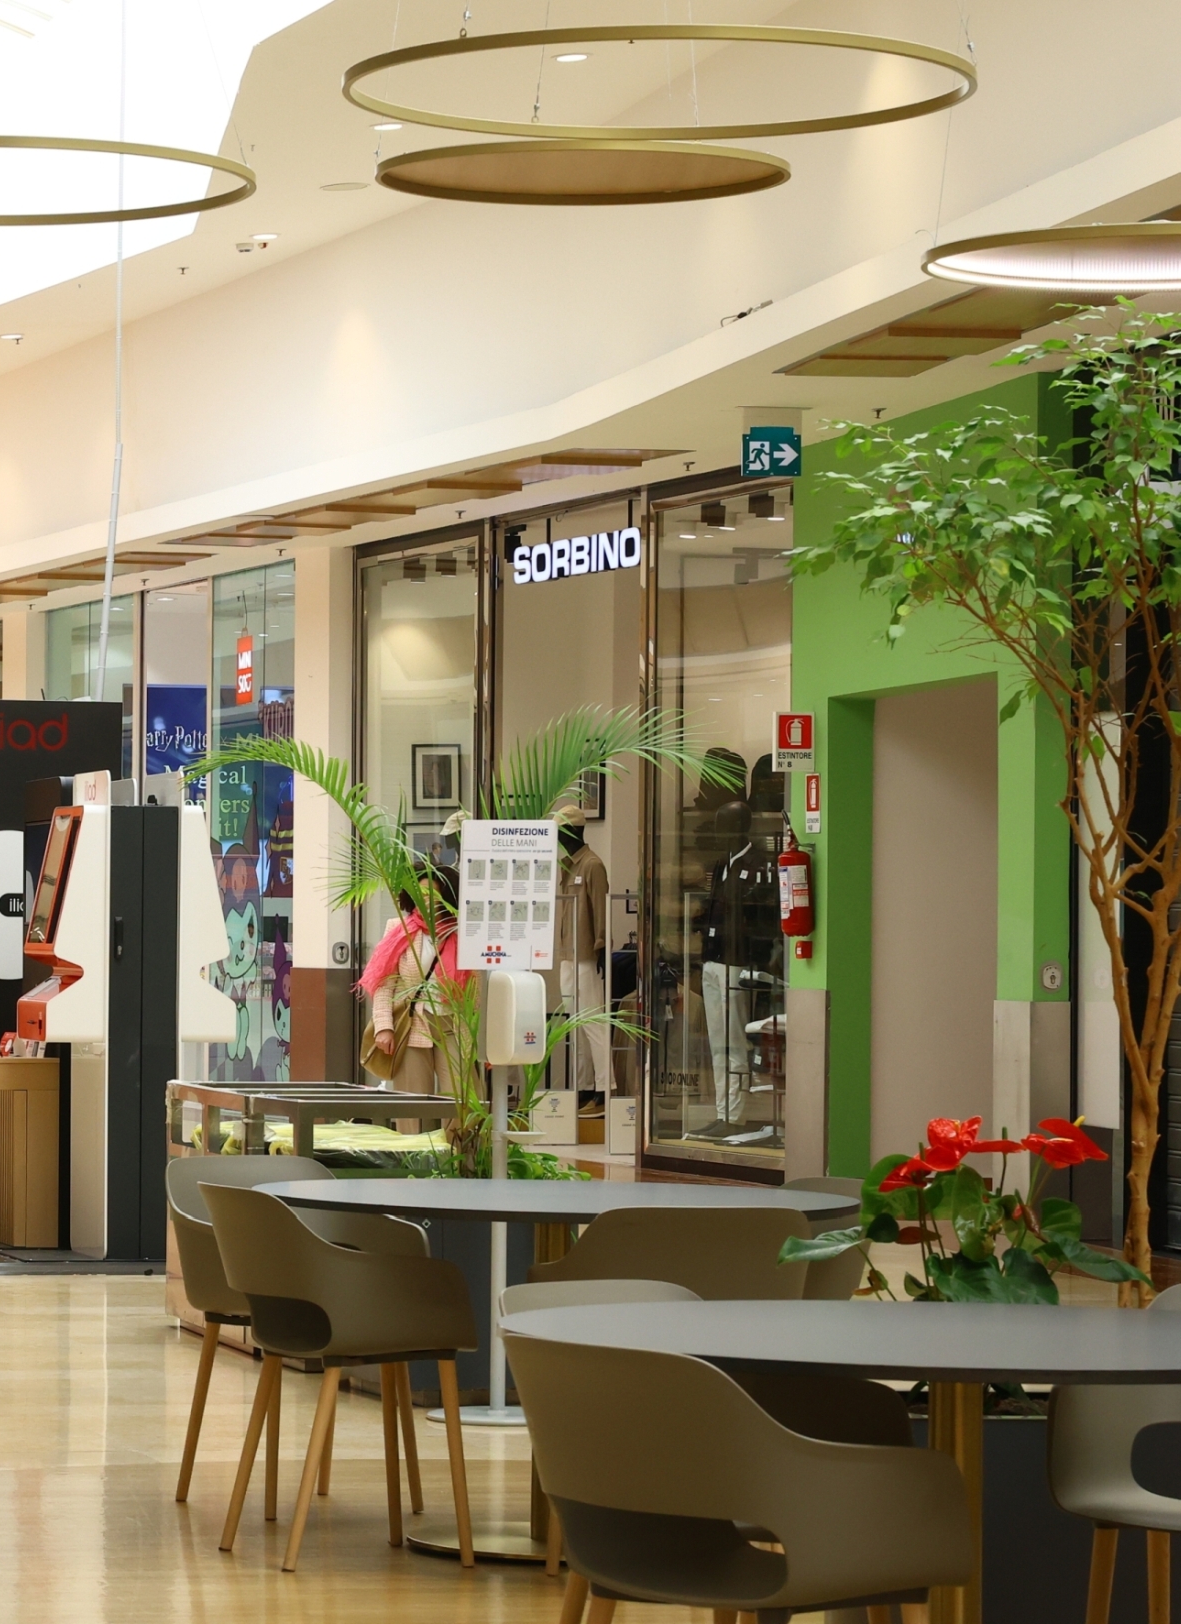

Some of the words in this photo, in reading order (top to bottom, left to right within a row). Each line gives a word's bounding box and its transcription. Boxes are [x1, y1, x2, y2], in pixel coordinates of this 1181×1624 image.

[513, 526, 641, 585] SORBINO
[777, 751, 812, 760] ESTINTORE
[492, 827, 549, 836] DISINFEZIONE
[491, 839, 515, 847] DELLE
[516, 839, 537, 848] MANI
[660, 1071, 676, 1085] SOP
